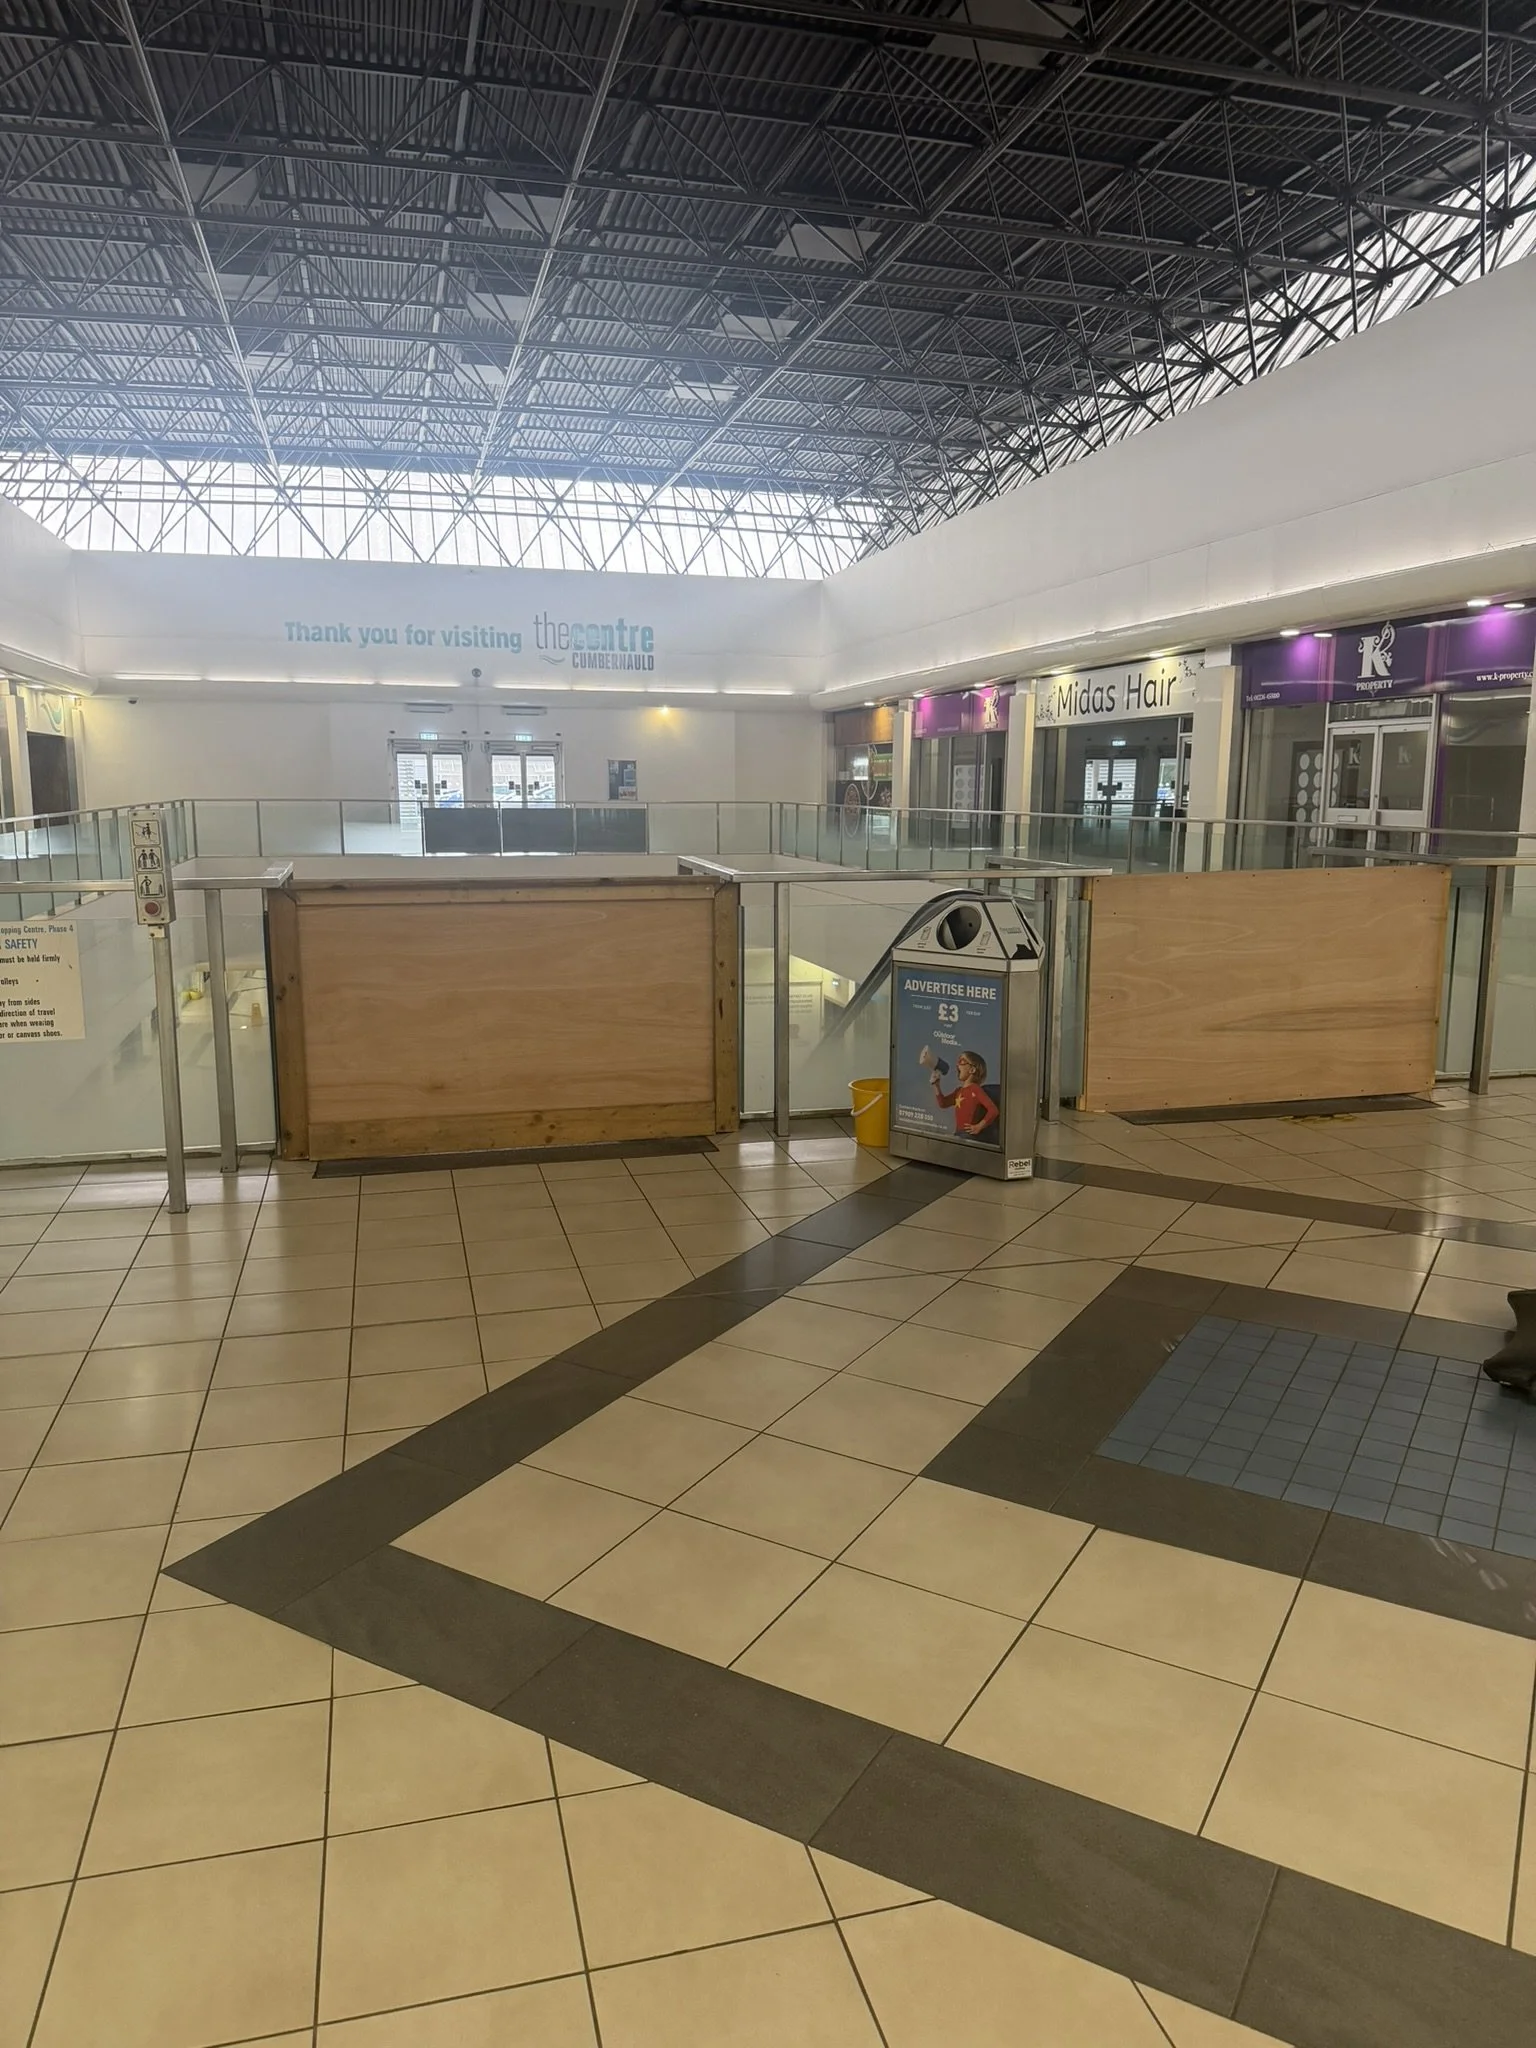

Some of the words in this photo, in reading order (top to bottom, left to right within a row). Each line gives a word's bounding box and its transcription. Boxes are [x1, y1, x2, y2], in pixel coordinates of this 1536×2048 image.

[284, 621, 352, 643] Thank
[358, 627, 397, 649] you
[405, 624, 435, 646] for
[440, 625, 522, 654] visiting
[572, 652, 654, 671] CUMBERNAULD
[1356, 680, 1393, 691] PROPERTY
[1057, 678, 1116, 717] Midas
[1126, 668, 1177, 710] Hair
[48, 925, 67, 933] Phase
[5, 938, 38, 949] SAFETY
[17, 955, 25, 963] be
[27, 954, 41, 963] held
[42, 954, 60, 964] firmly
[904, 978, 965, 997] ADVERTISE
[966, 985, 997, 1000] HERE
[8, 998, 23, 1006] from
[24, 997, 40, 1006] sides
[29, 1008, 36, 1016] of
[37, 1008, 56, 1016] travel
[938, 1002, 959, 1022] £3
[10, 1019, 28, 1028] when
[29, 1019, 55, 1028] wearing
[16, 1030, 41, 1039] canvass
[1008, 1160, 1031, 1169] Rebel
